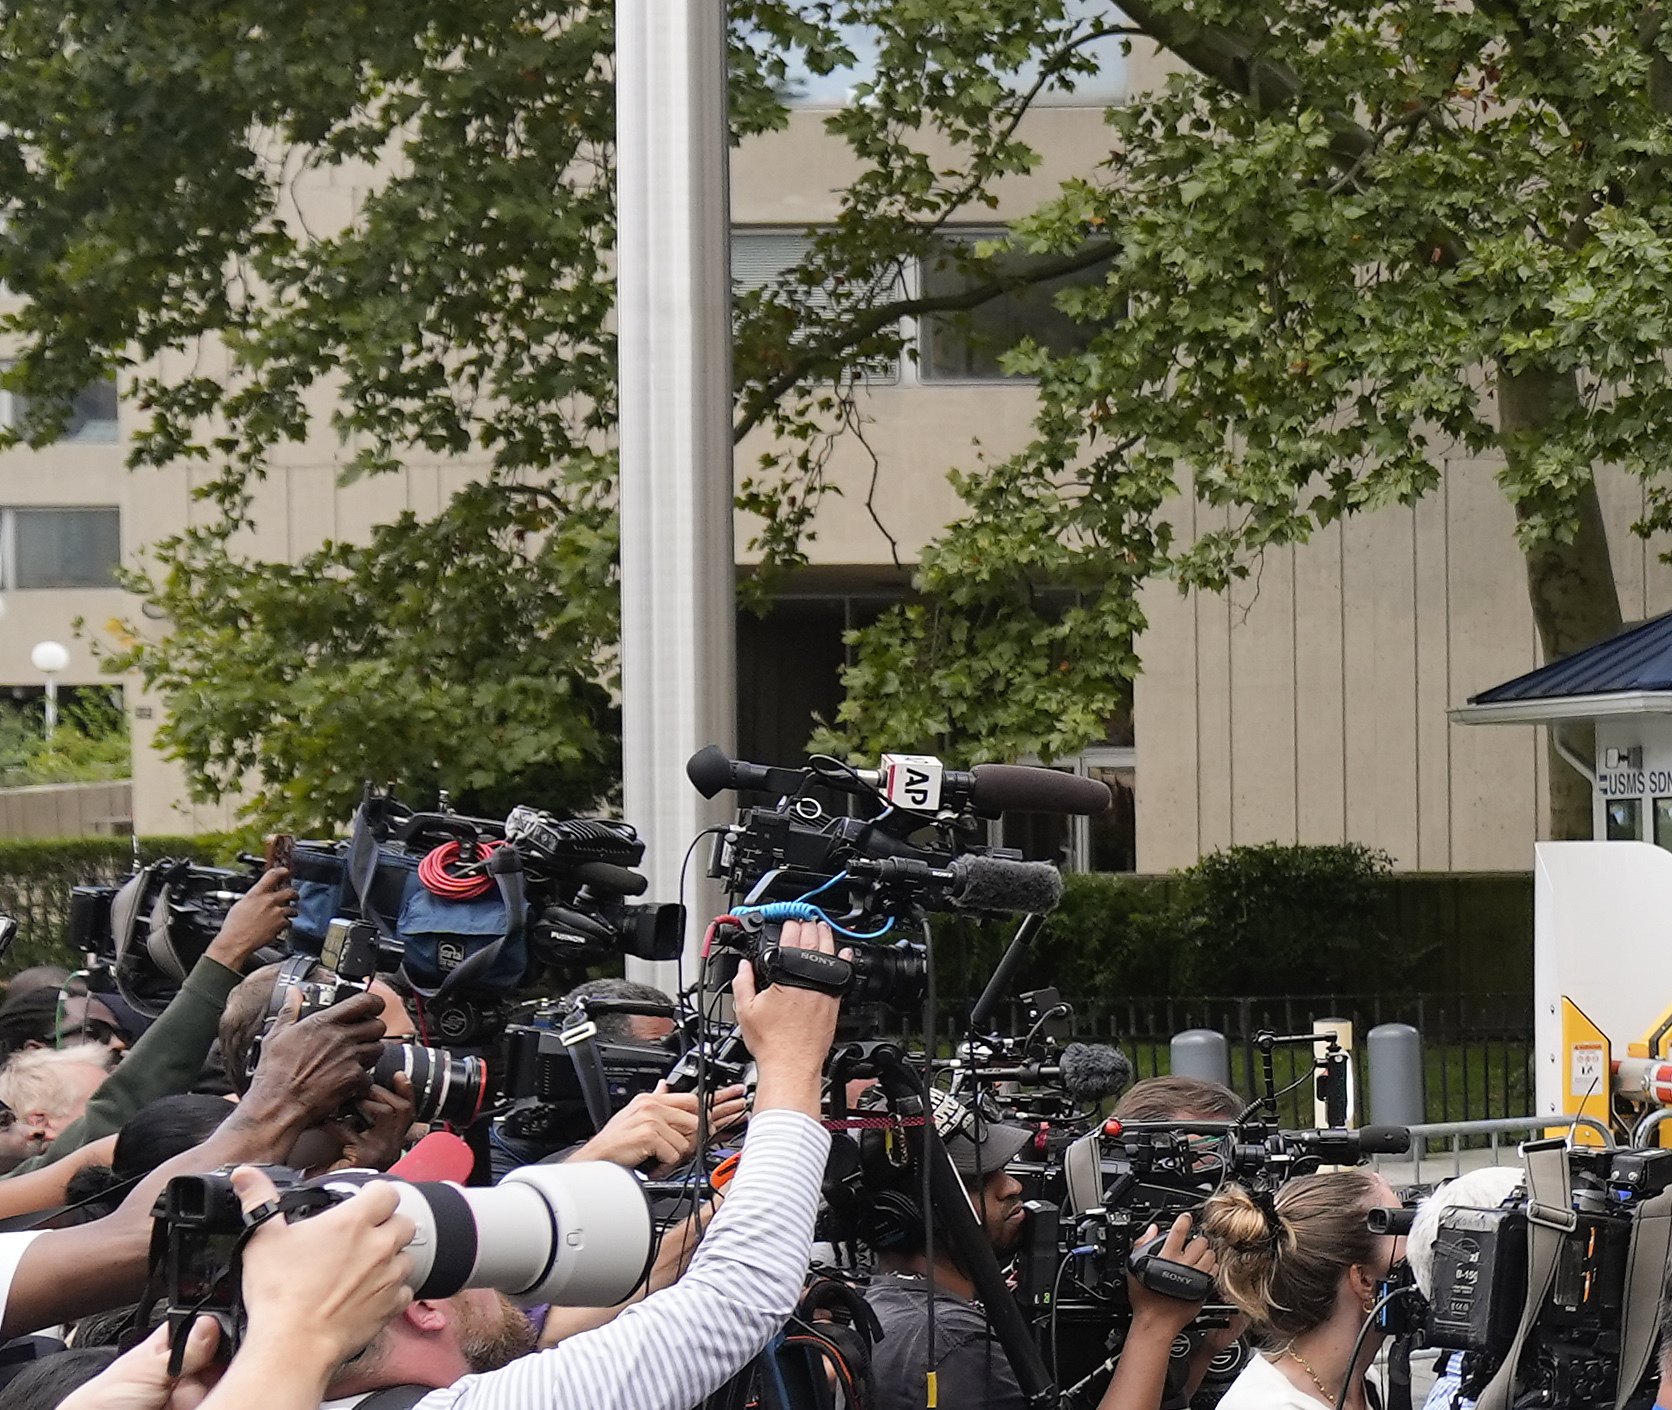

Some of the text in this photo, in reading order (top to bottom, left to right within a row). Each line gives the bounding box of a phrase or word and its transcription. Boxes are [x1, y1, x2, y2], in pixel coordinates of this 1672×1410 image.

[905, 768, 929, 805] AP
[1609, 772, 1645, 795] USMS
[801, 952, 836, 967] SONY
[1162, 1271, 1193, 1285] SONY
